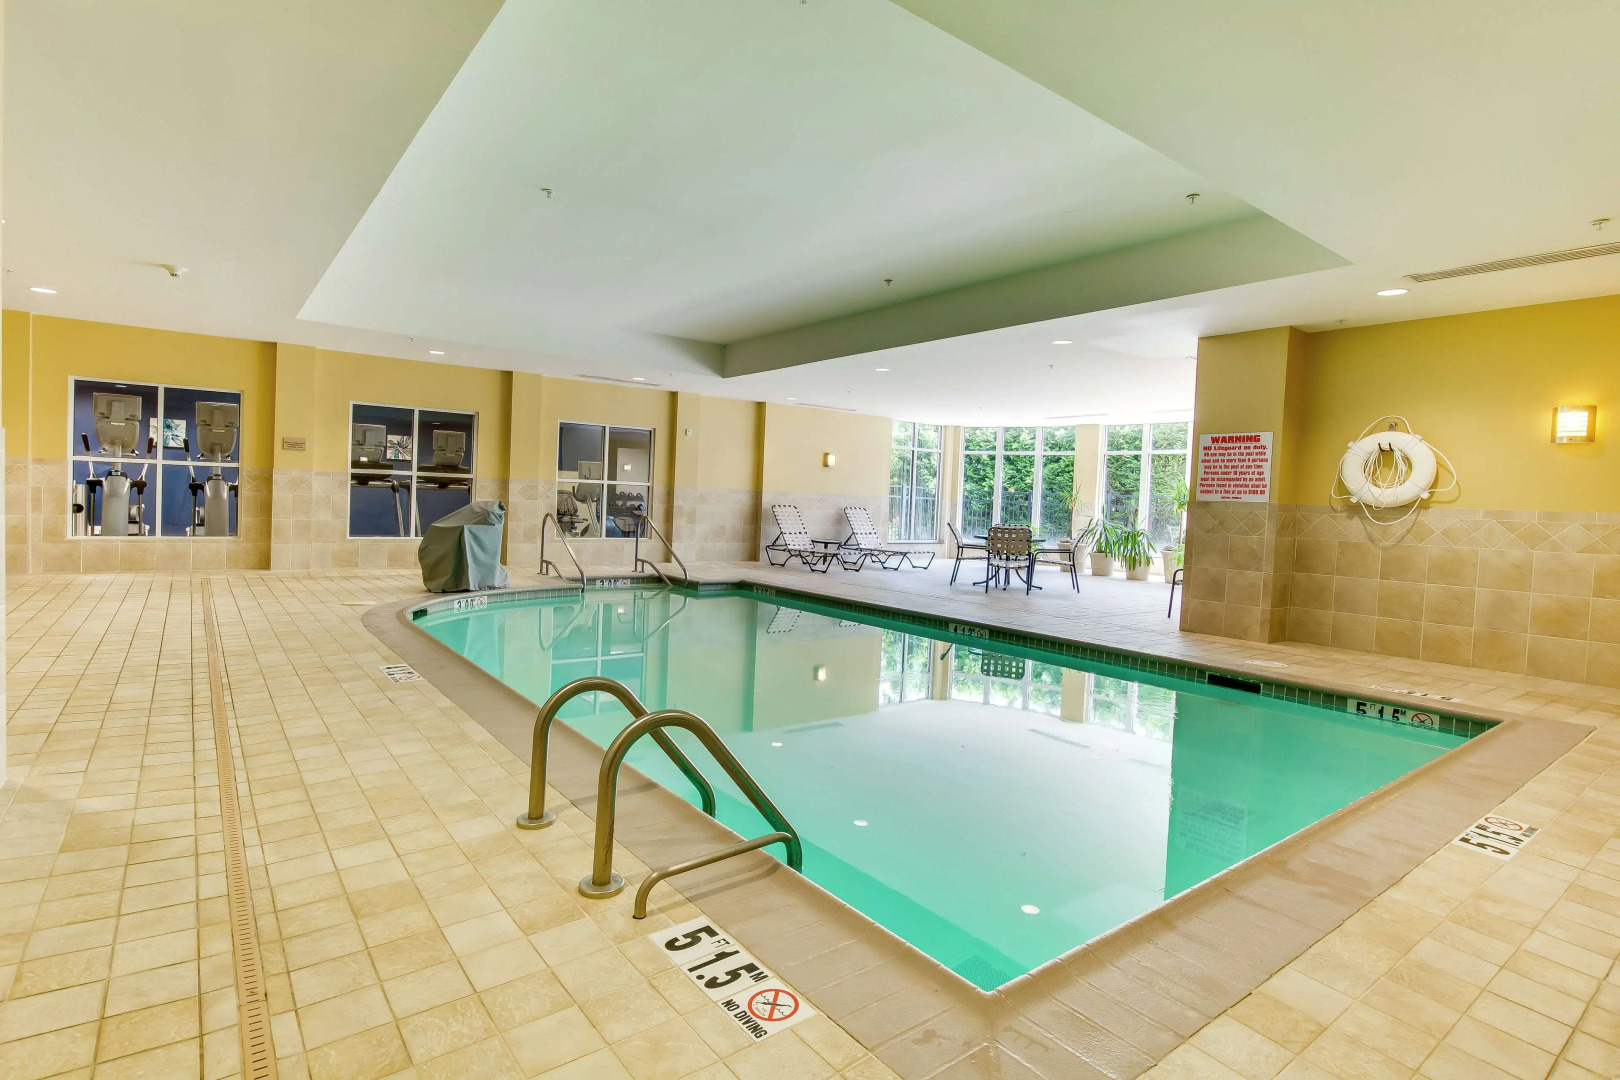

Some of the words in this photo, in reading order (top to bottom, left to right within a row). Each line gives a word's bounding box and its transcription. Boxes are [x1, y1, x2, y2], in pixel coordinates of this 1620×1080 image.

[1211, 435, 1260, 443] WARNING
[1356, 701, 1367, 714] 5
[1458, 836, 1510, 855] 5
[664, 925, 720, 951] 5
[710, 938, 730, 949] FT
[687, 950, 760, 989] 1.5
[749, 971, 769, 983] M
[721, 998, 740, 1012] NO
[733, 1009, 768, 1039] DIVING
